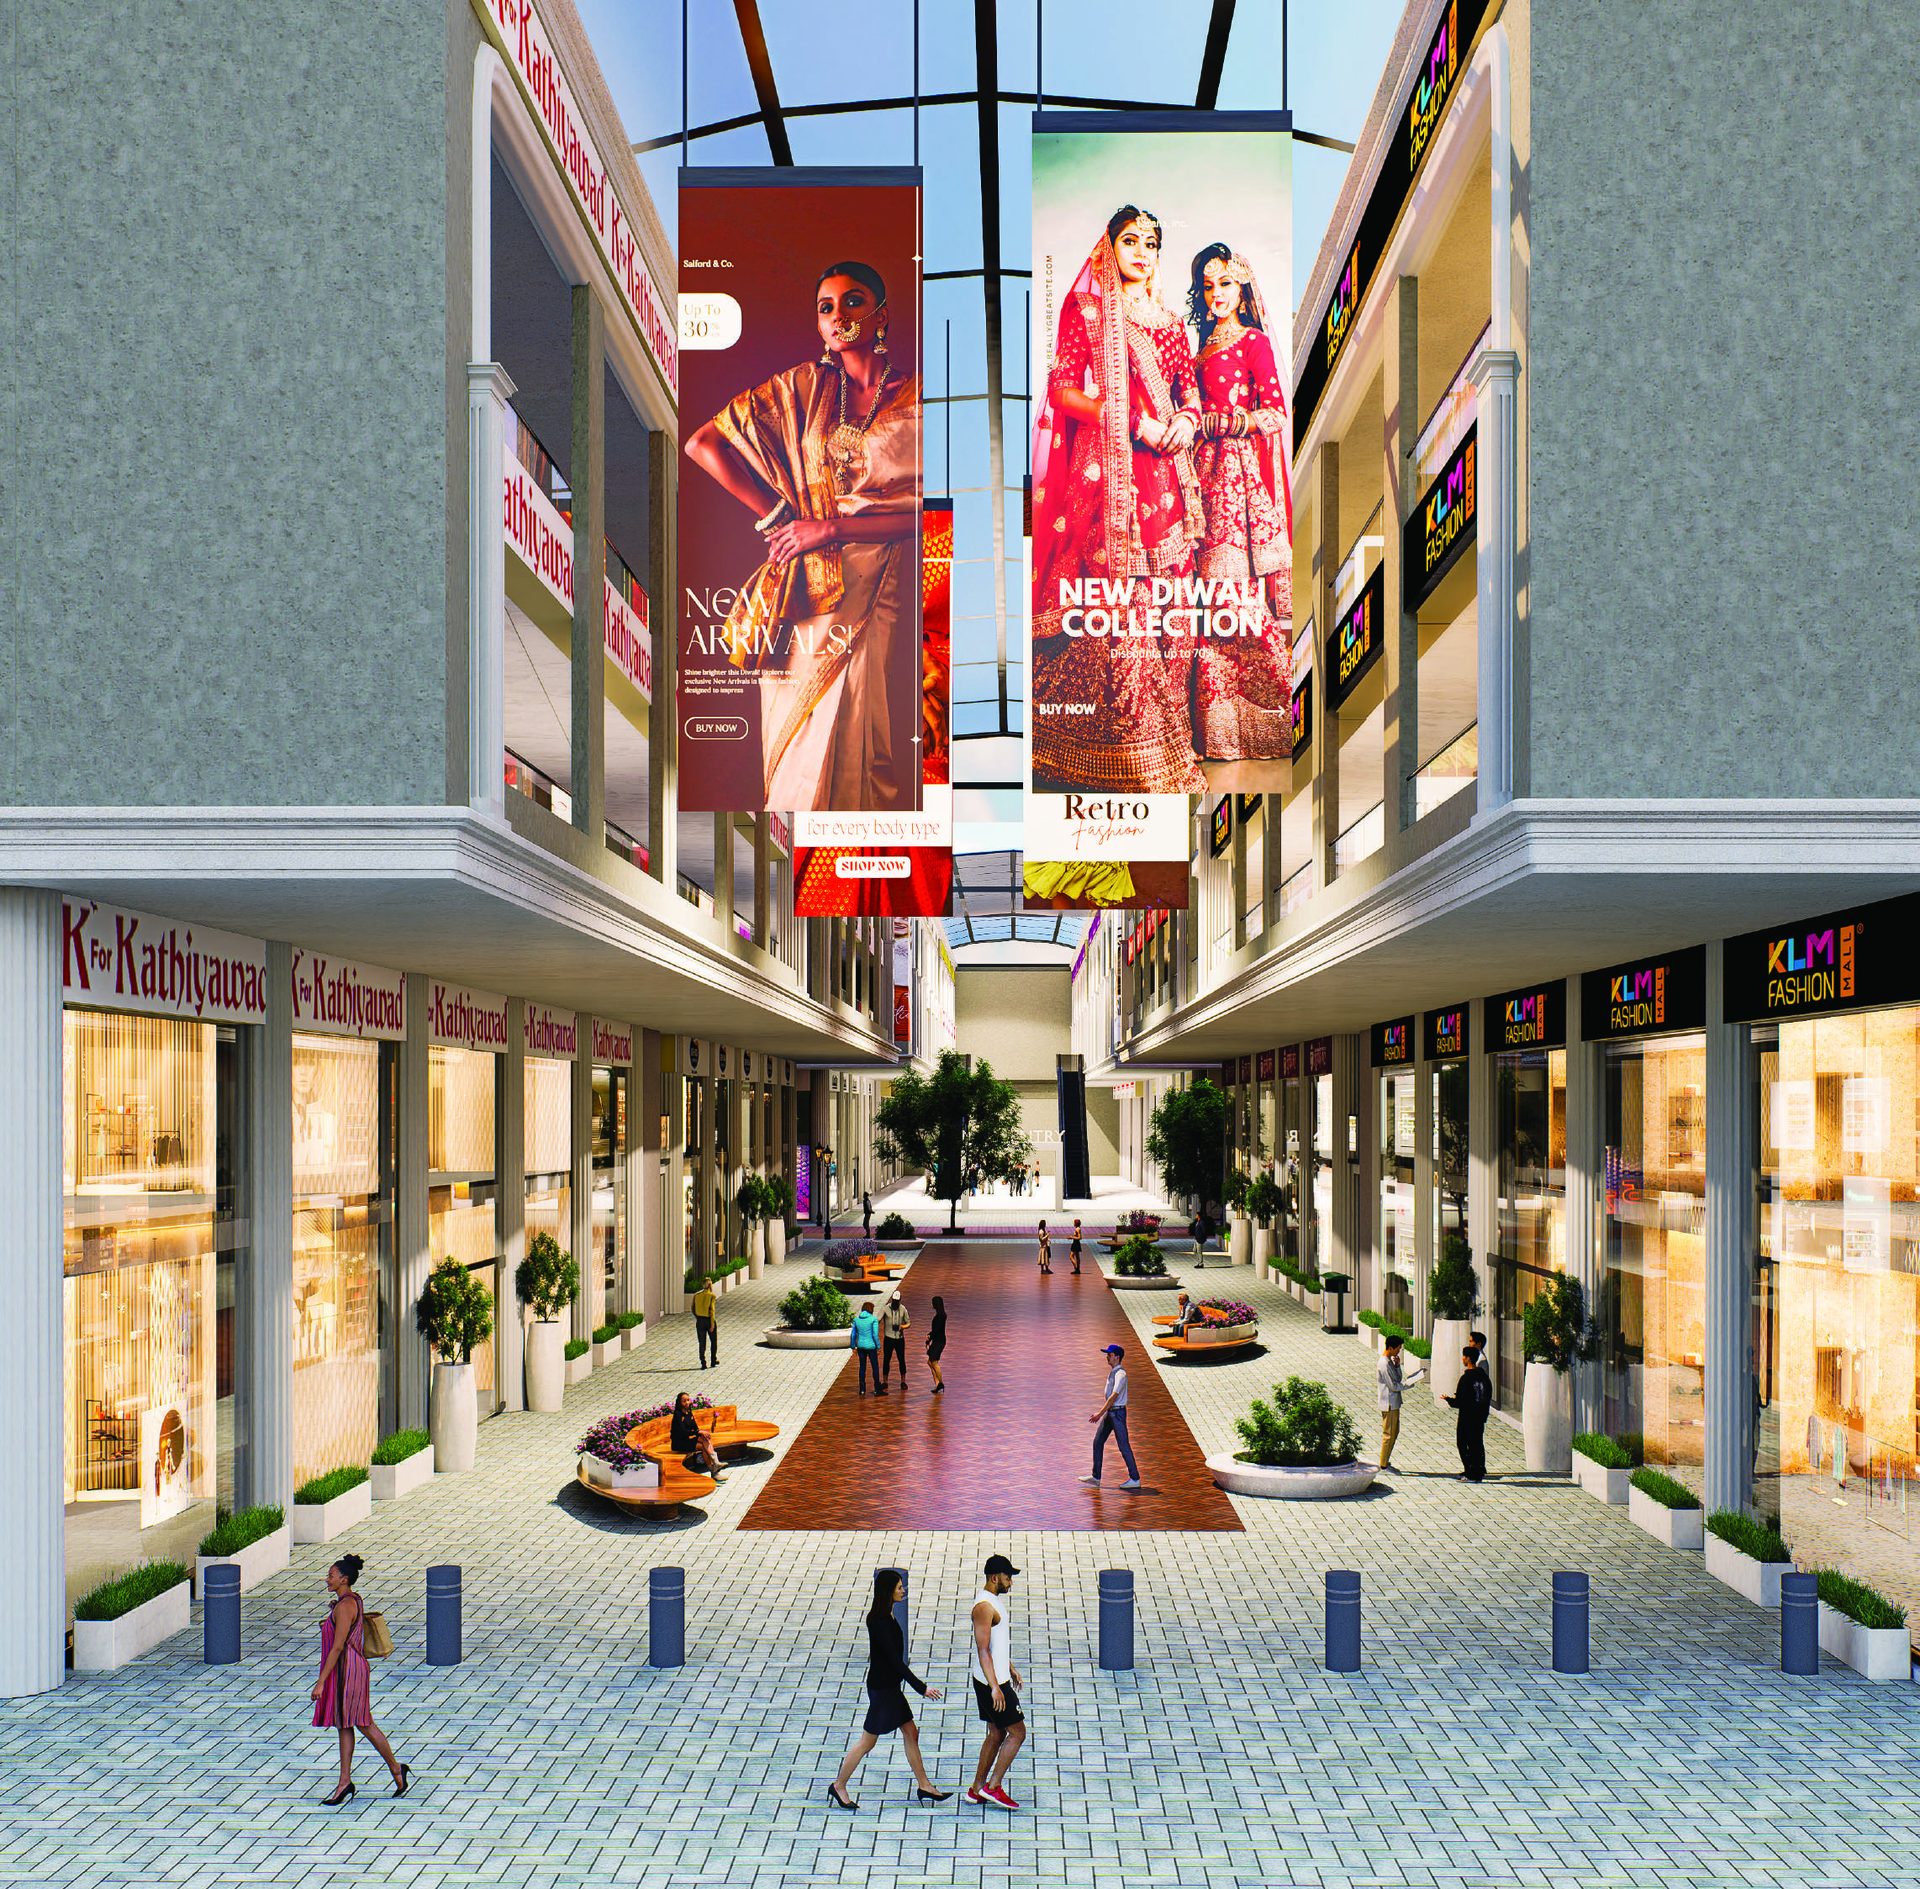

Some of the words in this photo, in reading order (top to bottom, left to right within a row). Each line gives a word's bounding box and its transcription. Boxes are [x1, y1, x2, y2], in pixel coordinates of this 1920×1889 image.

[1410, 24, 1446, 139] KLM
[1410, 64, 1446, 172] FASHION
[612, 195, 620, 274] K
[683, 260, 712, 268] Salford
[712, 260, 720, 268] &
[720, 260, 734, 268] Co.
[684, 304, 702, 318] Up
[705, 304, 720, 316] To
[684, 321, 708, 338] 30
[1426, 456, 1463, 539] KLM
[504, 472, 574, 606] athiyawa
[1426, 499, 1464, 572] FASHION
[1058, 578, 1137, 606] NEW
[1152, 578, 1266, 606] DIWALI
[604, 582, 651, 692] Kathiyawa
[1061, 608, 1263, 638] COLLECTION
[1340, 602, 1364, 658] KLM
[686, 624, 853, 655] ARRIVALS!
[1164, 650, 1178, 660] up
[1180, 649, 1191, 658] to
[1039, 704, 1064, 714] BUY
[1065, 704, 1096, 714] NOW
[696, 724, 714, 732] BUY
[715, 724, 738, 732] NOW
[1064, 794, 1150, 820] Retro
[807, 818, 830, 836] for
[832, 822, 870, 840] every
[874, 818, 907, 840] body
[842, 861, 875, 872] SHOP
[878, 861, 906, 872] NOW
[62, 903, 91, 990] K
[91, 938, 113, 972] For
[1768, 929, 1834, 975] KLM
[1842, 929, 1853, 993] MALL
[300, 978, 312, 1004] For
[312, 958, 404, 1036] Kathiyawad
[1611, 970, 1652, 1003] KLM
[1768, 971, 1834, 1008] FASHION
[434, 985, 508, 1048] Kathiyawad
[1436, 1014, 1456, 1034] KLM
[1506, 996, 1535, 1023] KLM
[1611, 1002, 1652, 1030] FASHION
[1384, 1026, 1400, 1044] KLM
[1506, 1023, 1536, 1044] FASHION
